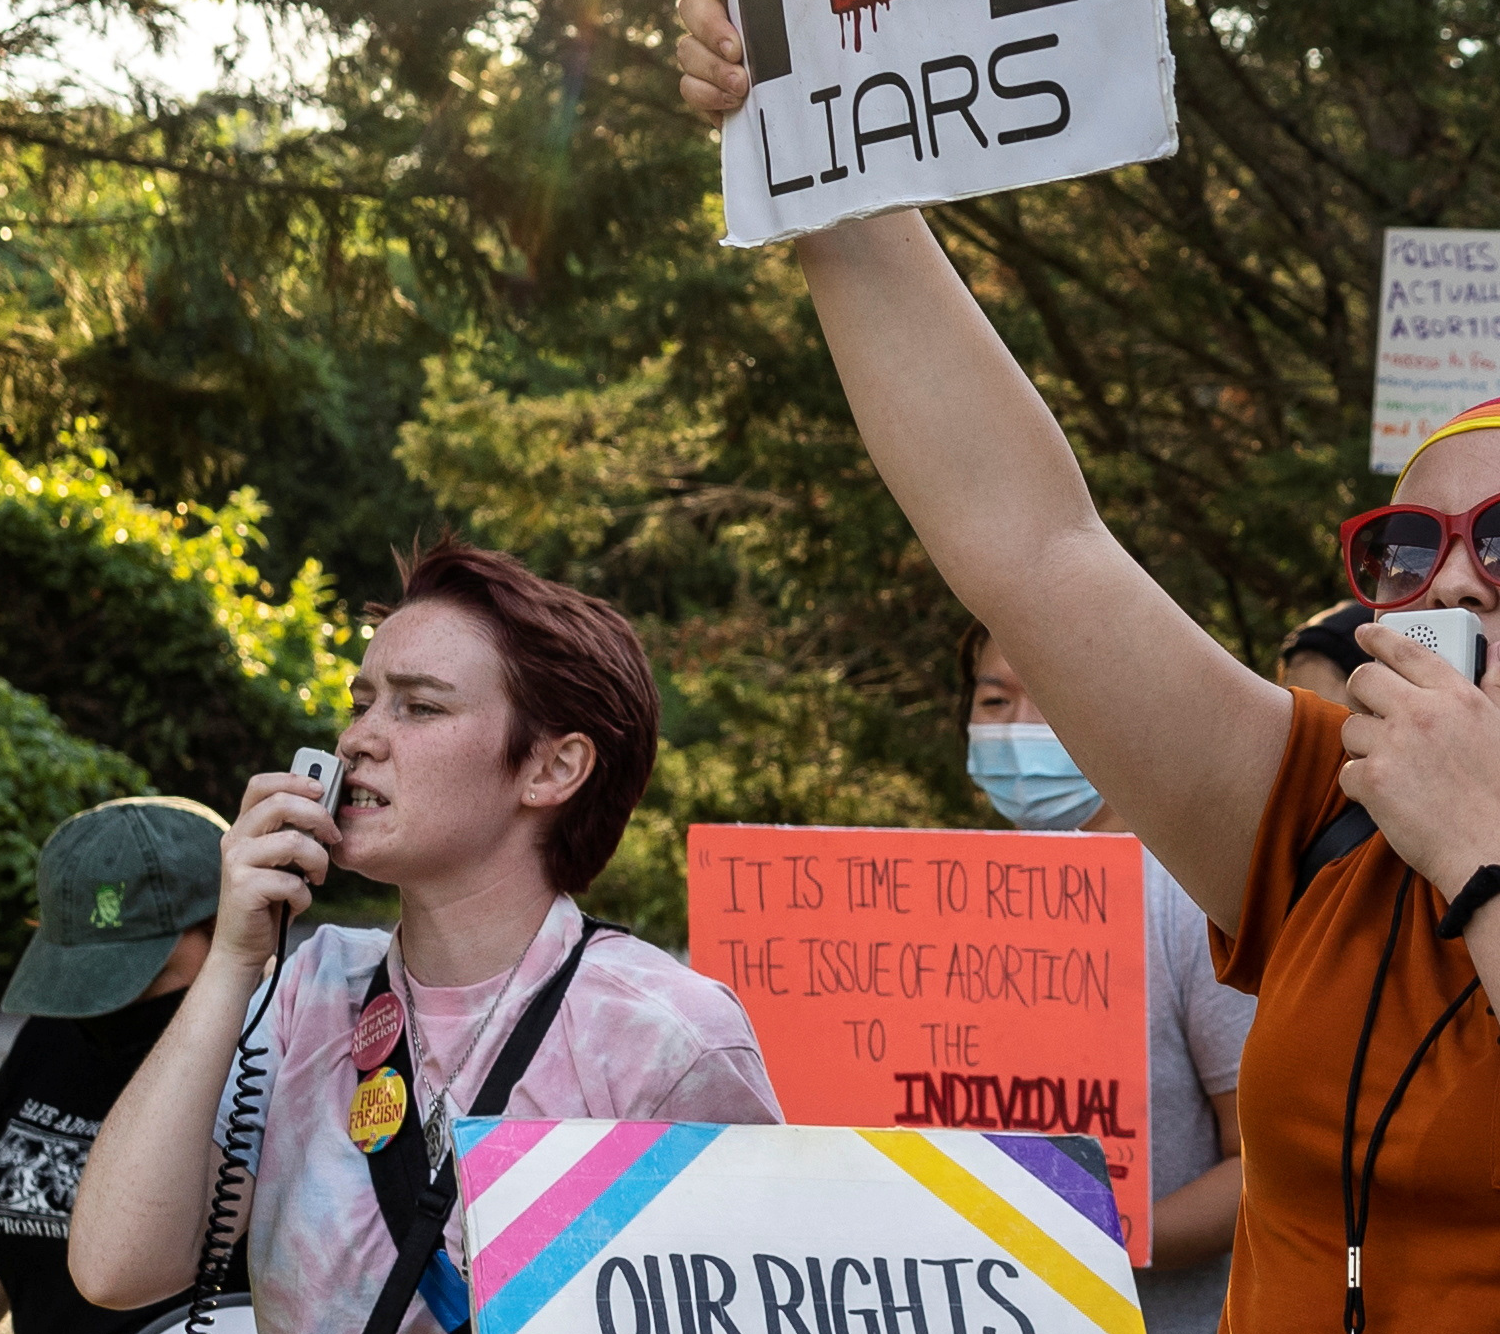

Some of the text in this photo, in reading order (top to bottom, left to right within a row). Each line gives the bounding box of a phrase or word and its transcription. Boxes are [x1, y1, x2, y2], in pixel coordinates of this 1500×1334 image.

[758, 31, 1076, 198] LIARS
[1390, 235, 1499, 273] POLICIES
[785, 855, 824, 912] IS
[837, 856, 913, 915] TIME
[927, 859, 968, 916] TO
[984, 860, 1107, 924] RETURN
[718, 937, 1111, 1011] THE ISSUE OF ABORTION
[351, 1021, 398, 1056] Abortion
[843, 1018, 981, 1068] TO THE
[350, 1102, 404, 1131] FASCISM
[360, 1085, 394, 1110] FUCK
[894, 1072, 1136, 1139] INDIVIDUAL
